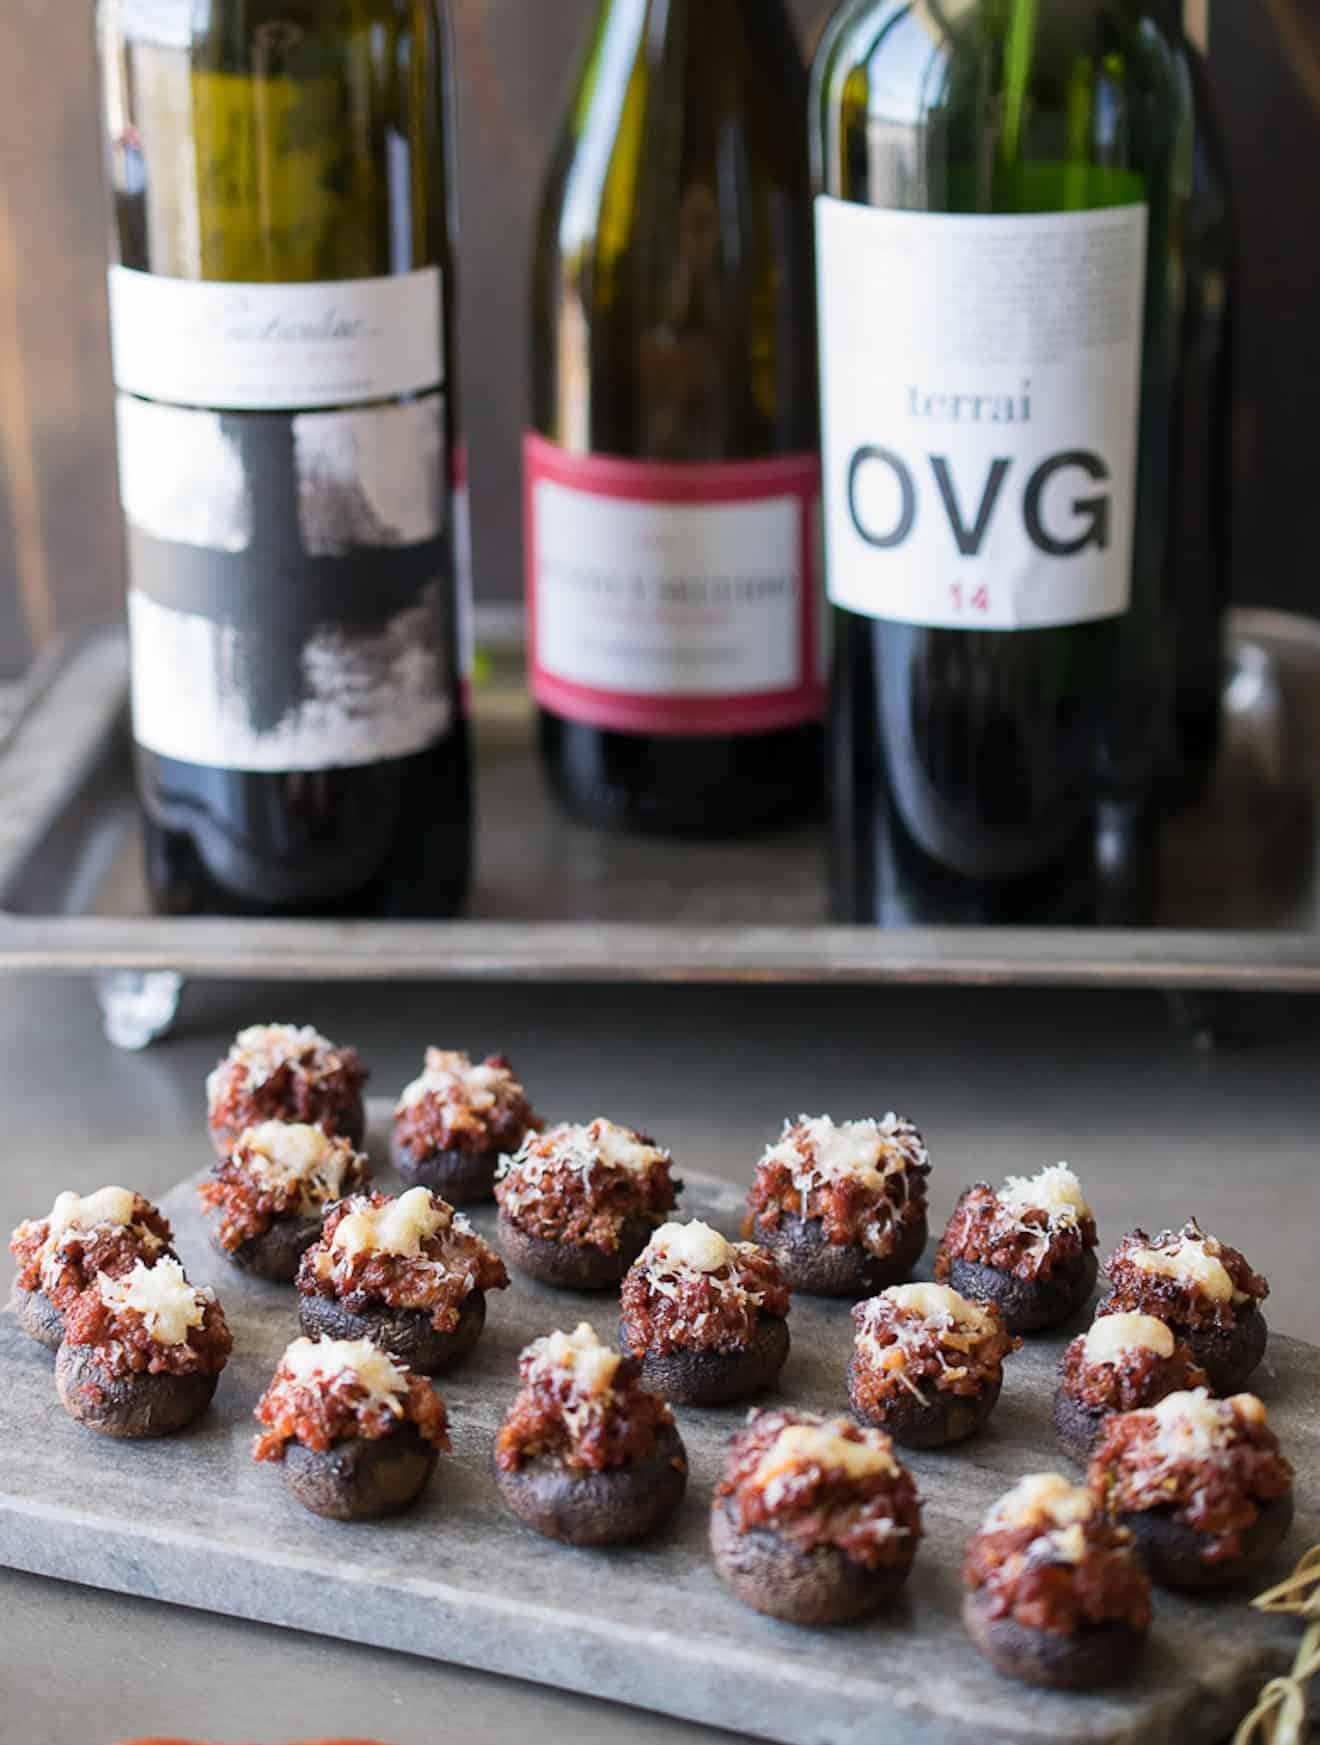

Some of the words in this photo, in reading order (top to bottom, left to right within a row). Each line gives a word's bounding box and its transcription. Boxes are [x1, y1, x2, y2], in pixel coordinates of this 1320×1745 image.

[909, 381, 1032, 423] terrai
[848, 445, 1111, 556] OVG
[950, 584, 989, 612] 14
